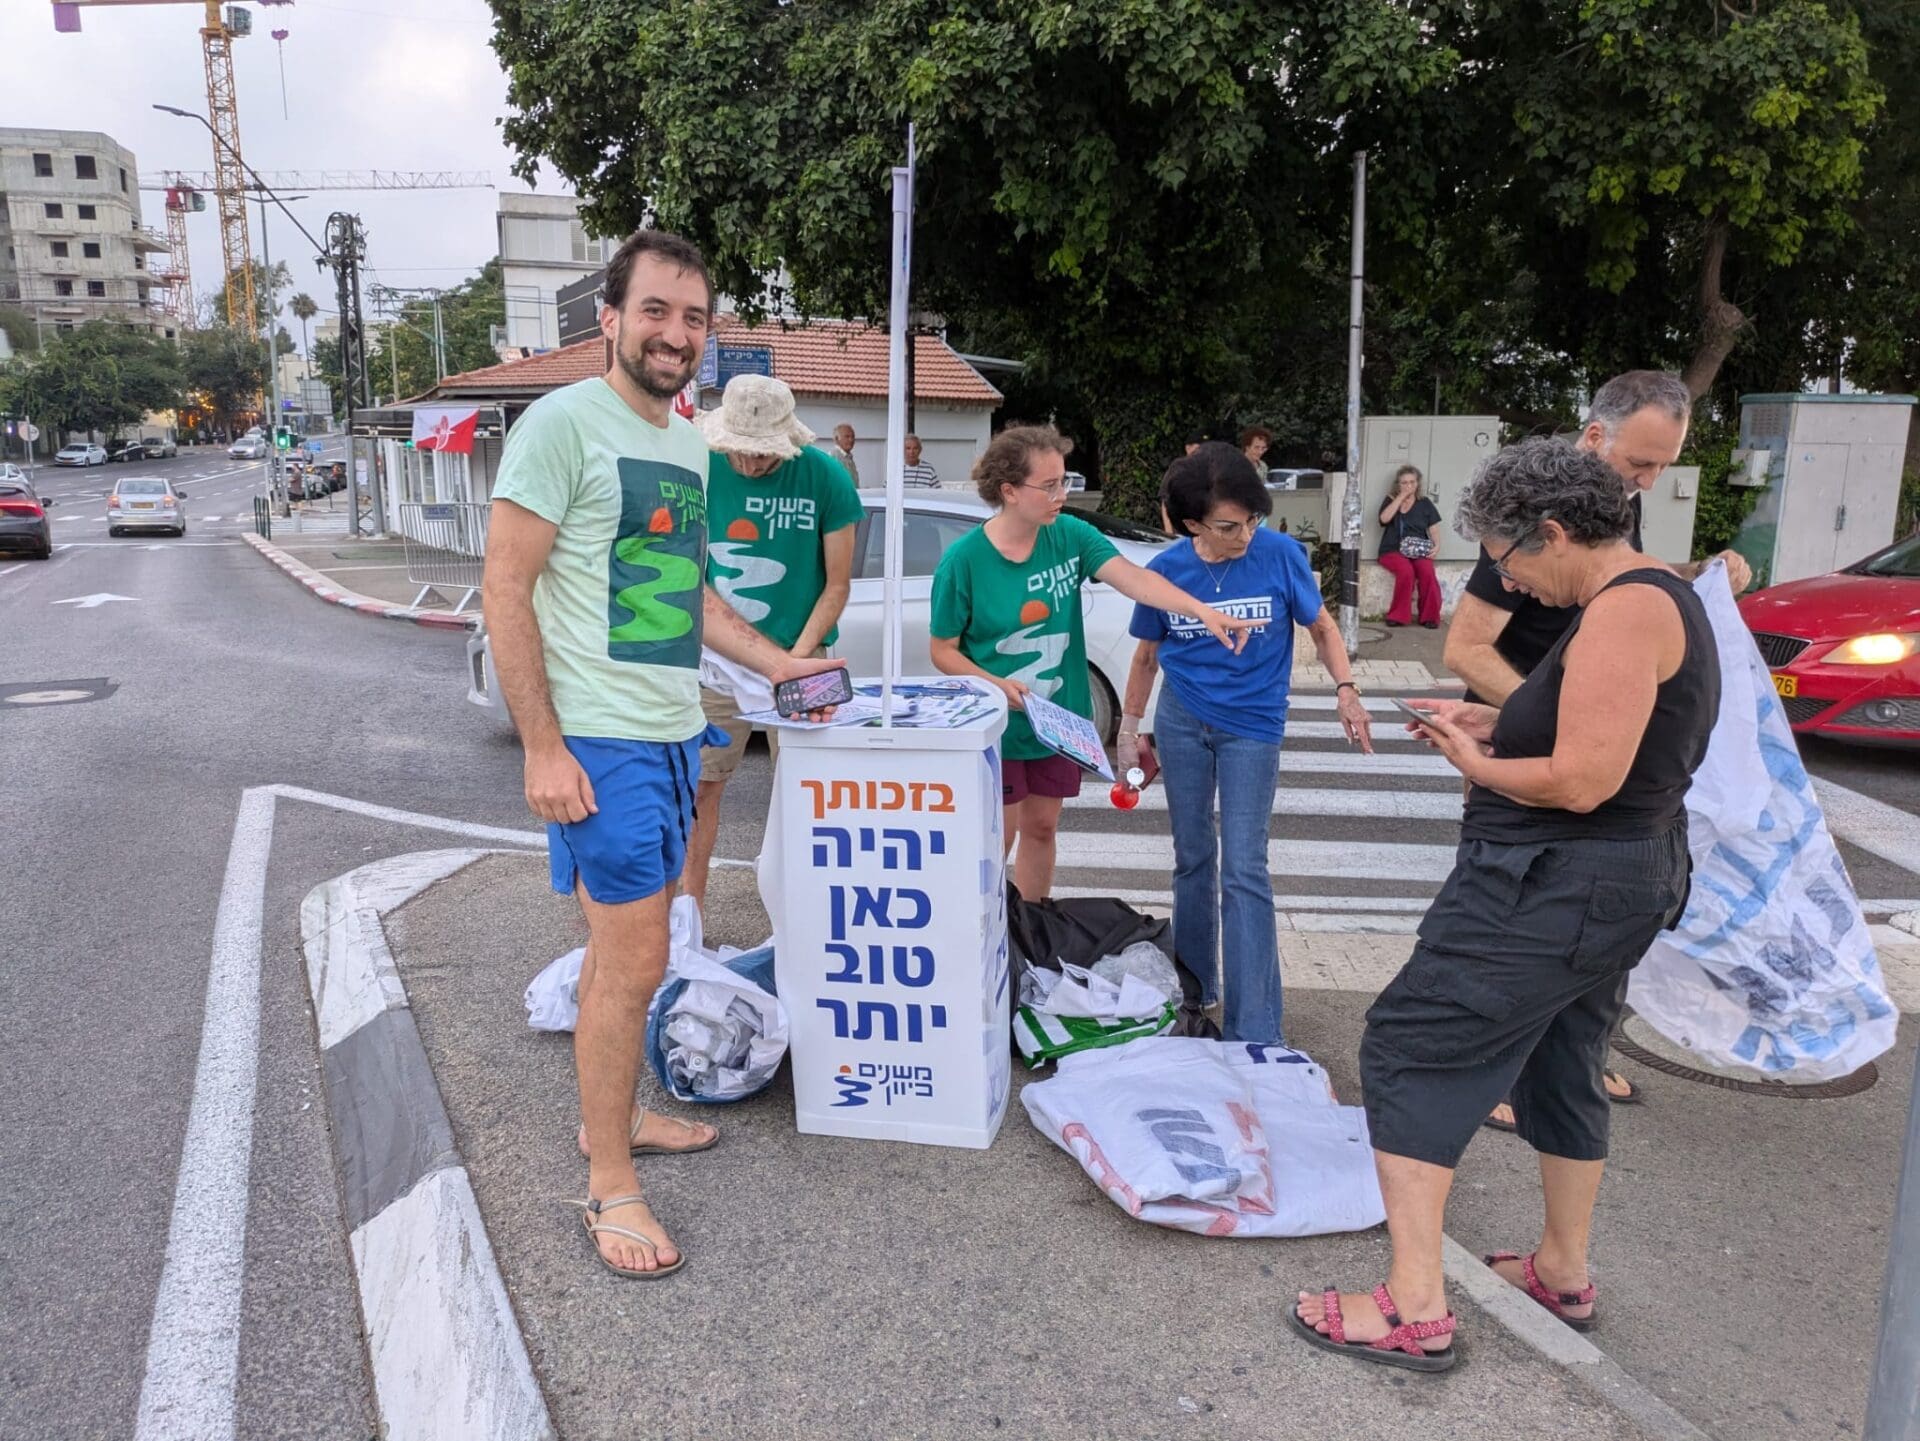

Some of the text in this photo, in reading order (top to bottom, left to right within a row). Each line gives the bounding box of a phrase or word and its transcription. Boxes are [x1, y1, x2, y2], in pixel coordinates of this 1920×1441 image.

[659, 481, 705, 508] משנים
[745, 496, 816, 520] משנים
[768, 513, 815, 540] כיוון
[1776, 677, 1793, 694] 76
[800, 780, 956, 819] בזכותך
[812, 827, 946, 871] יהיה
[829, 885, 932, 940] כאן
[824, 943, 936, 987] טוב
[816, 998, 947, 1043] יותר
[858, 1063, 933, 1086] משנים
[886, 1081, 933, 1106] כיוון
